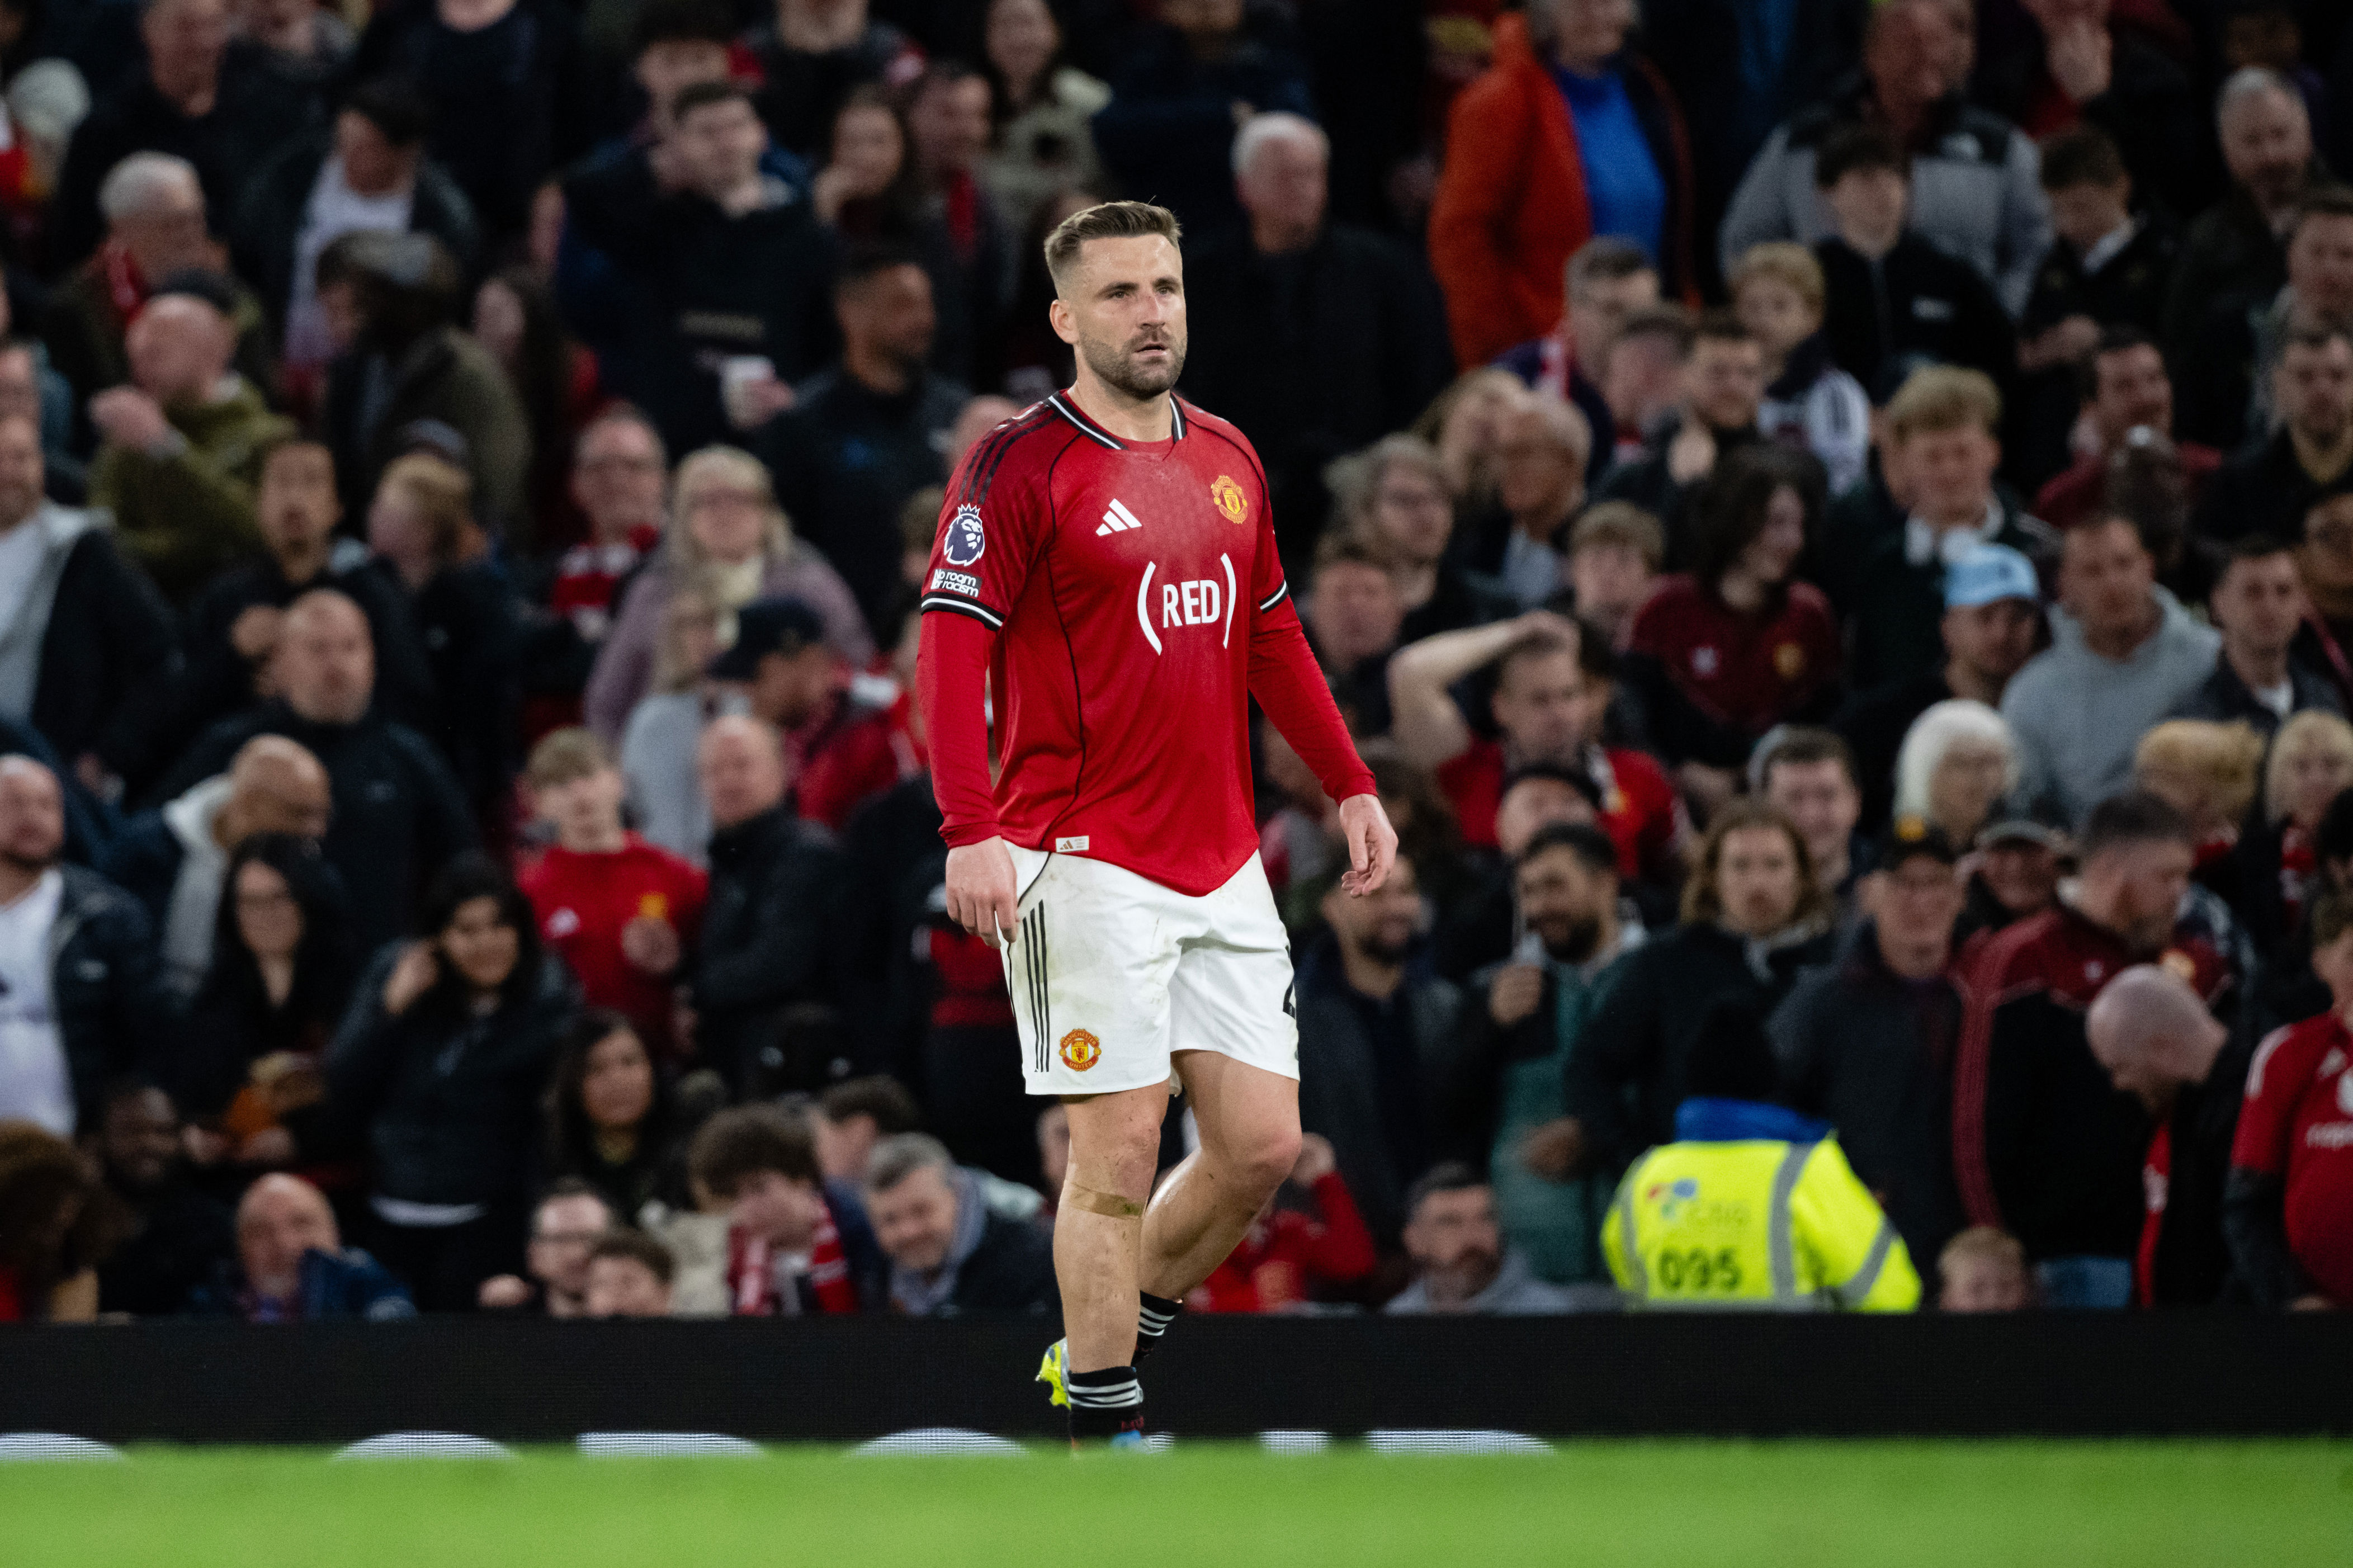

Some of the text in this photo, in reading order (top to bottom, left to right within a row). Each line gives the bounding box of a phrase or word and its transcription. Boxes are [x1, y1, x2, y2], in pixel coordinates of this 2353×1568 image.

[1227, 512, 1246, 520] UNITED
[934, 569, 976, 586] No room
[942, 580, 979, 597] racism
[1064, 1032, 1096, 1045] MANCHESTER
[1657, 1247, 1742, 1292] 095
